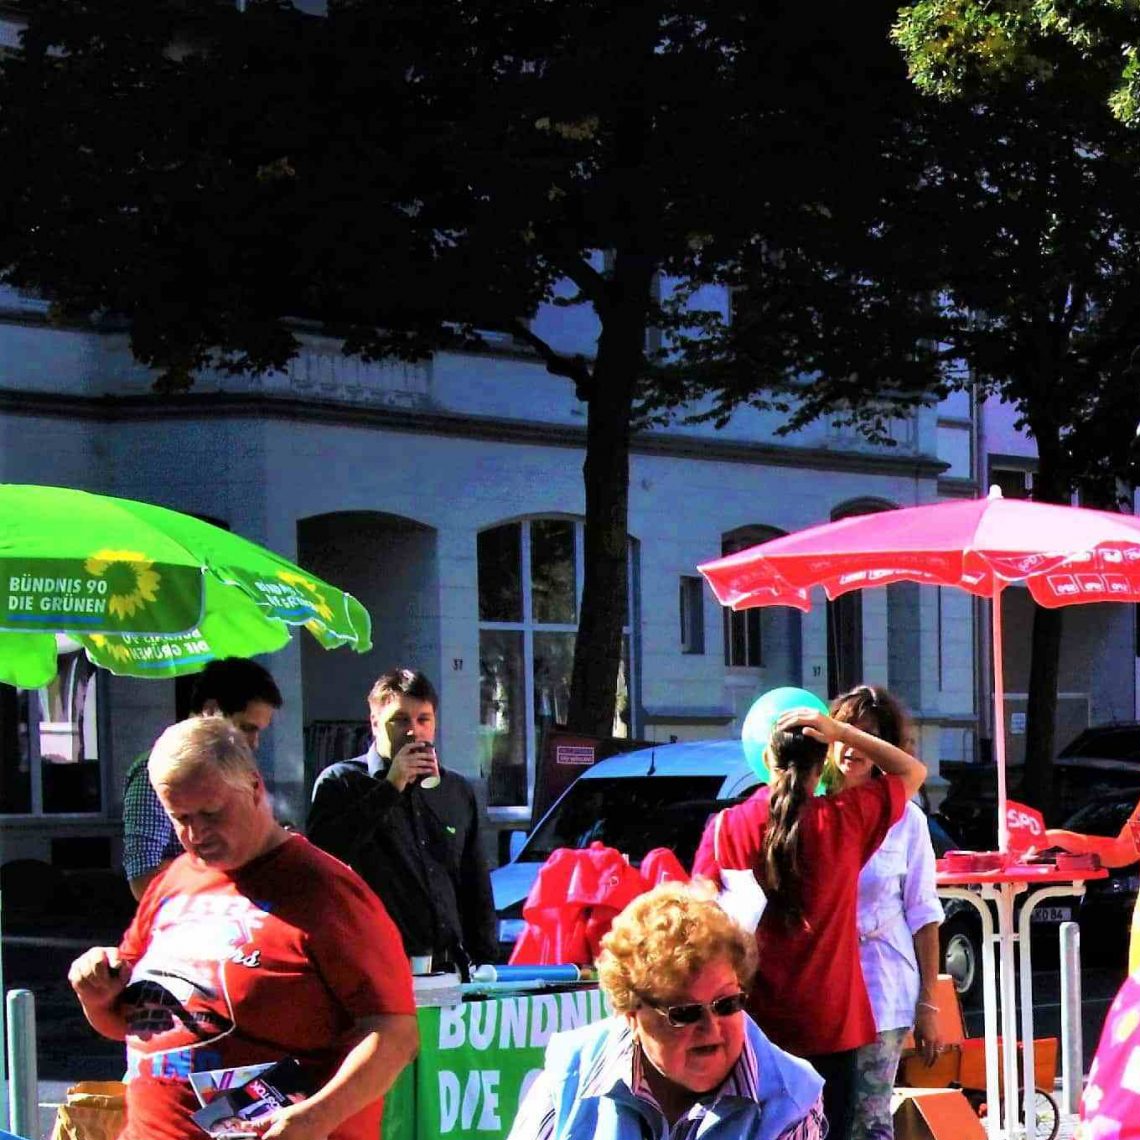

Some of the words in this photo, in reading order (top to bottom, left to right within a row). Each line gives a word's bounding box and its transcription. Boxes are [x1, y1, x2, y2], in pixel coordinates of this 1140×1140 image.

[9, 573, 82, 593] BÜNDNIS
[86, 580, 107, 595] 90
[8, 596, 34, 611] DIE
[40, 593, 106, 613] GRÜNEN
[1007, 809, 1041, 836] SPD
[438, 1070, 501, 1133] DIE
